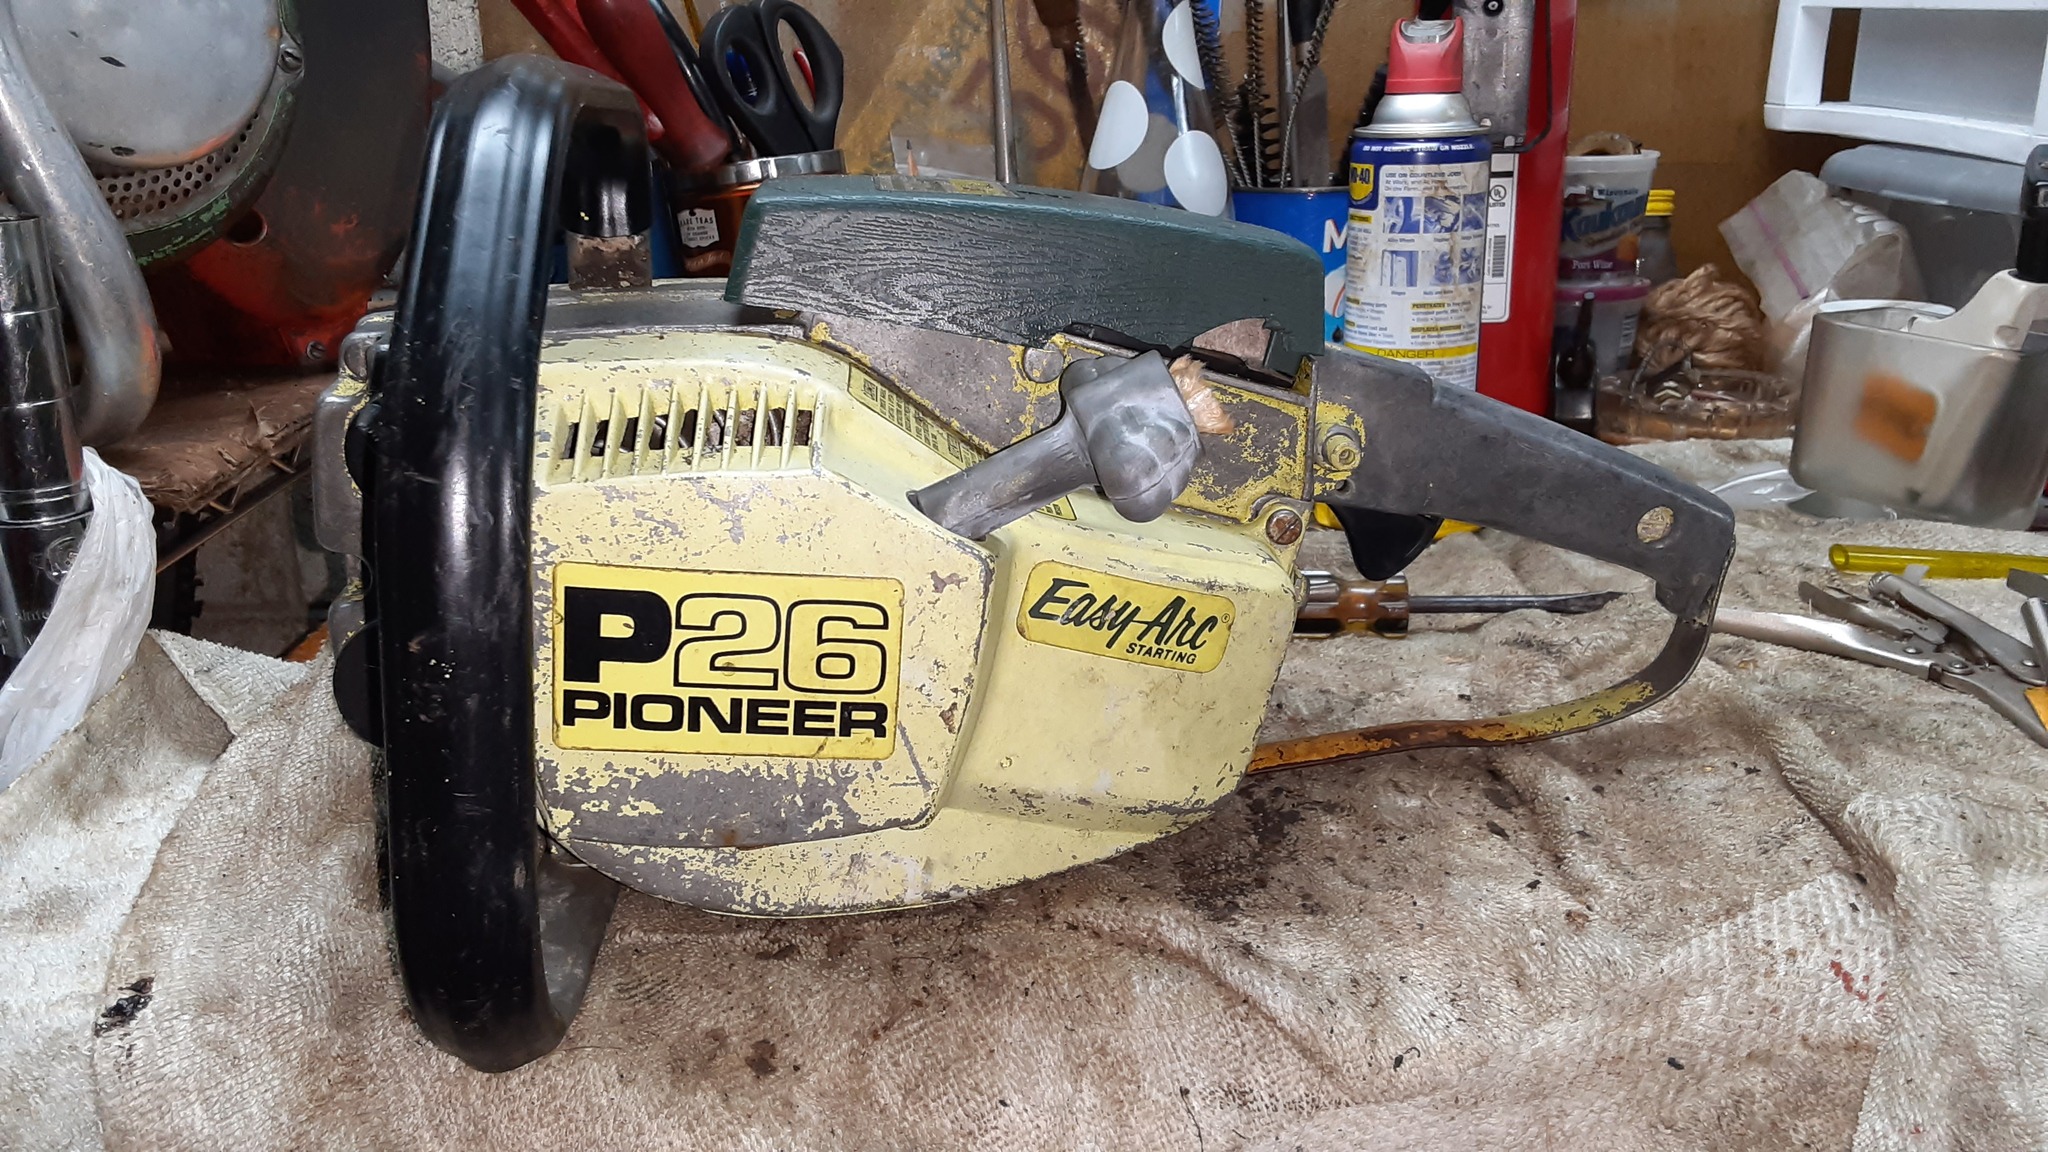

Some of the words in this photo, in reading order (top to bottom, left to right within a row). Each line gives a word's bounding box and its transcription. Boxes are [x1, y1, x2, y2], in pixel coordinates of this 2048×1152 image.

[1377, 349, 1435, 359] DANGER
[563, 586, 889, 695] P26
[1126, 642, 1198, 665] STARTING
[563, 689, 888, 738] PIONEER
